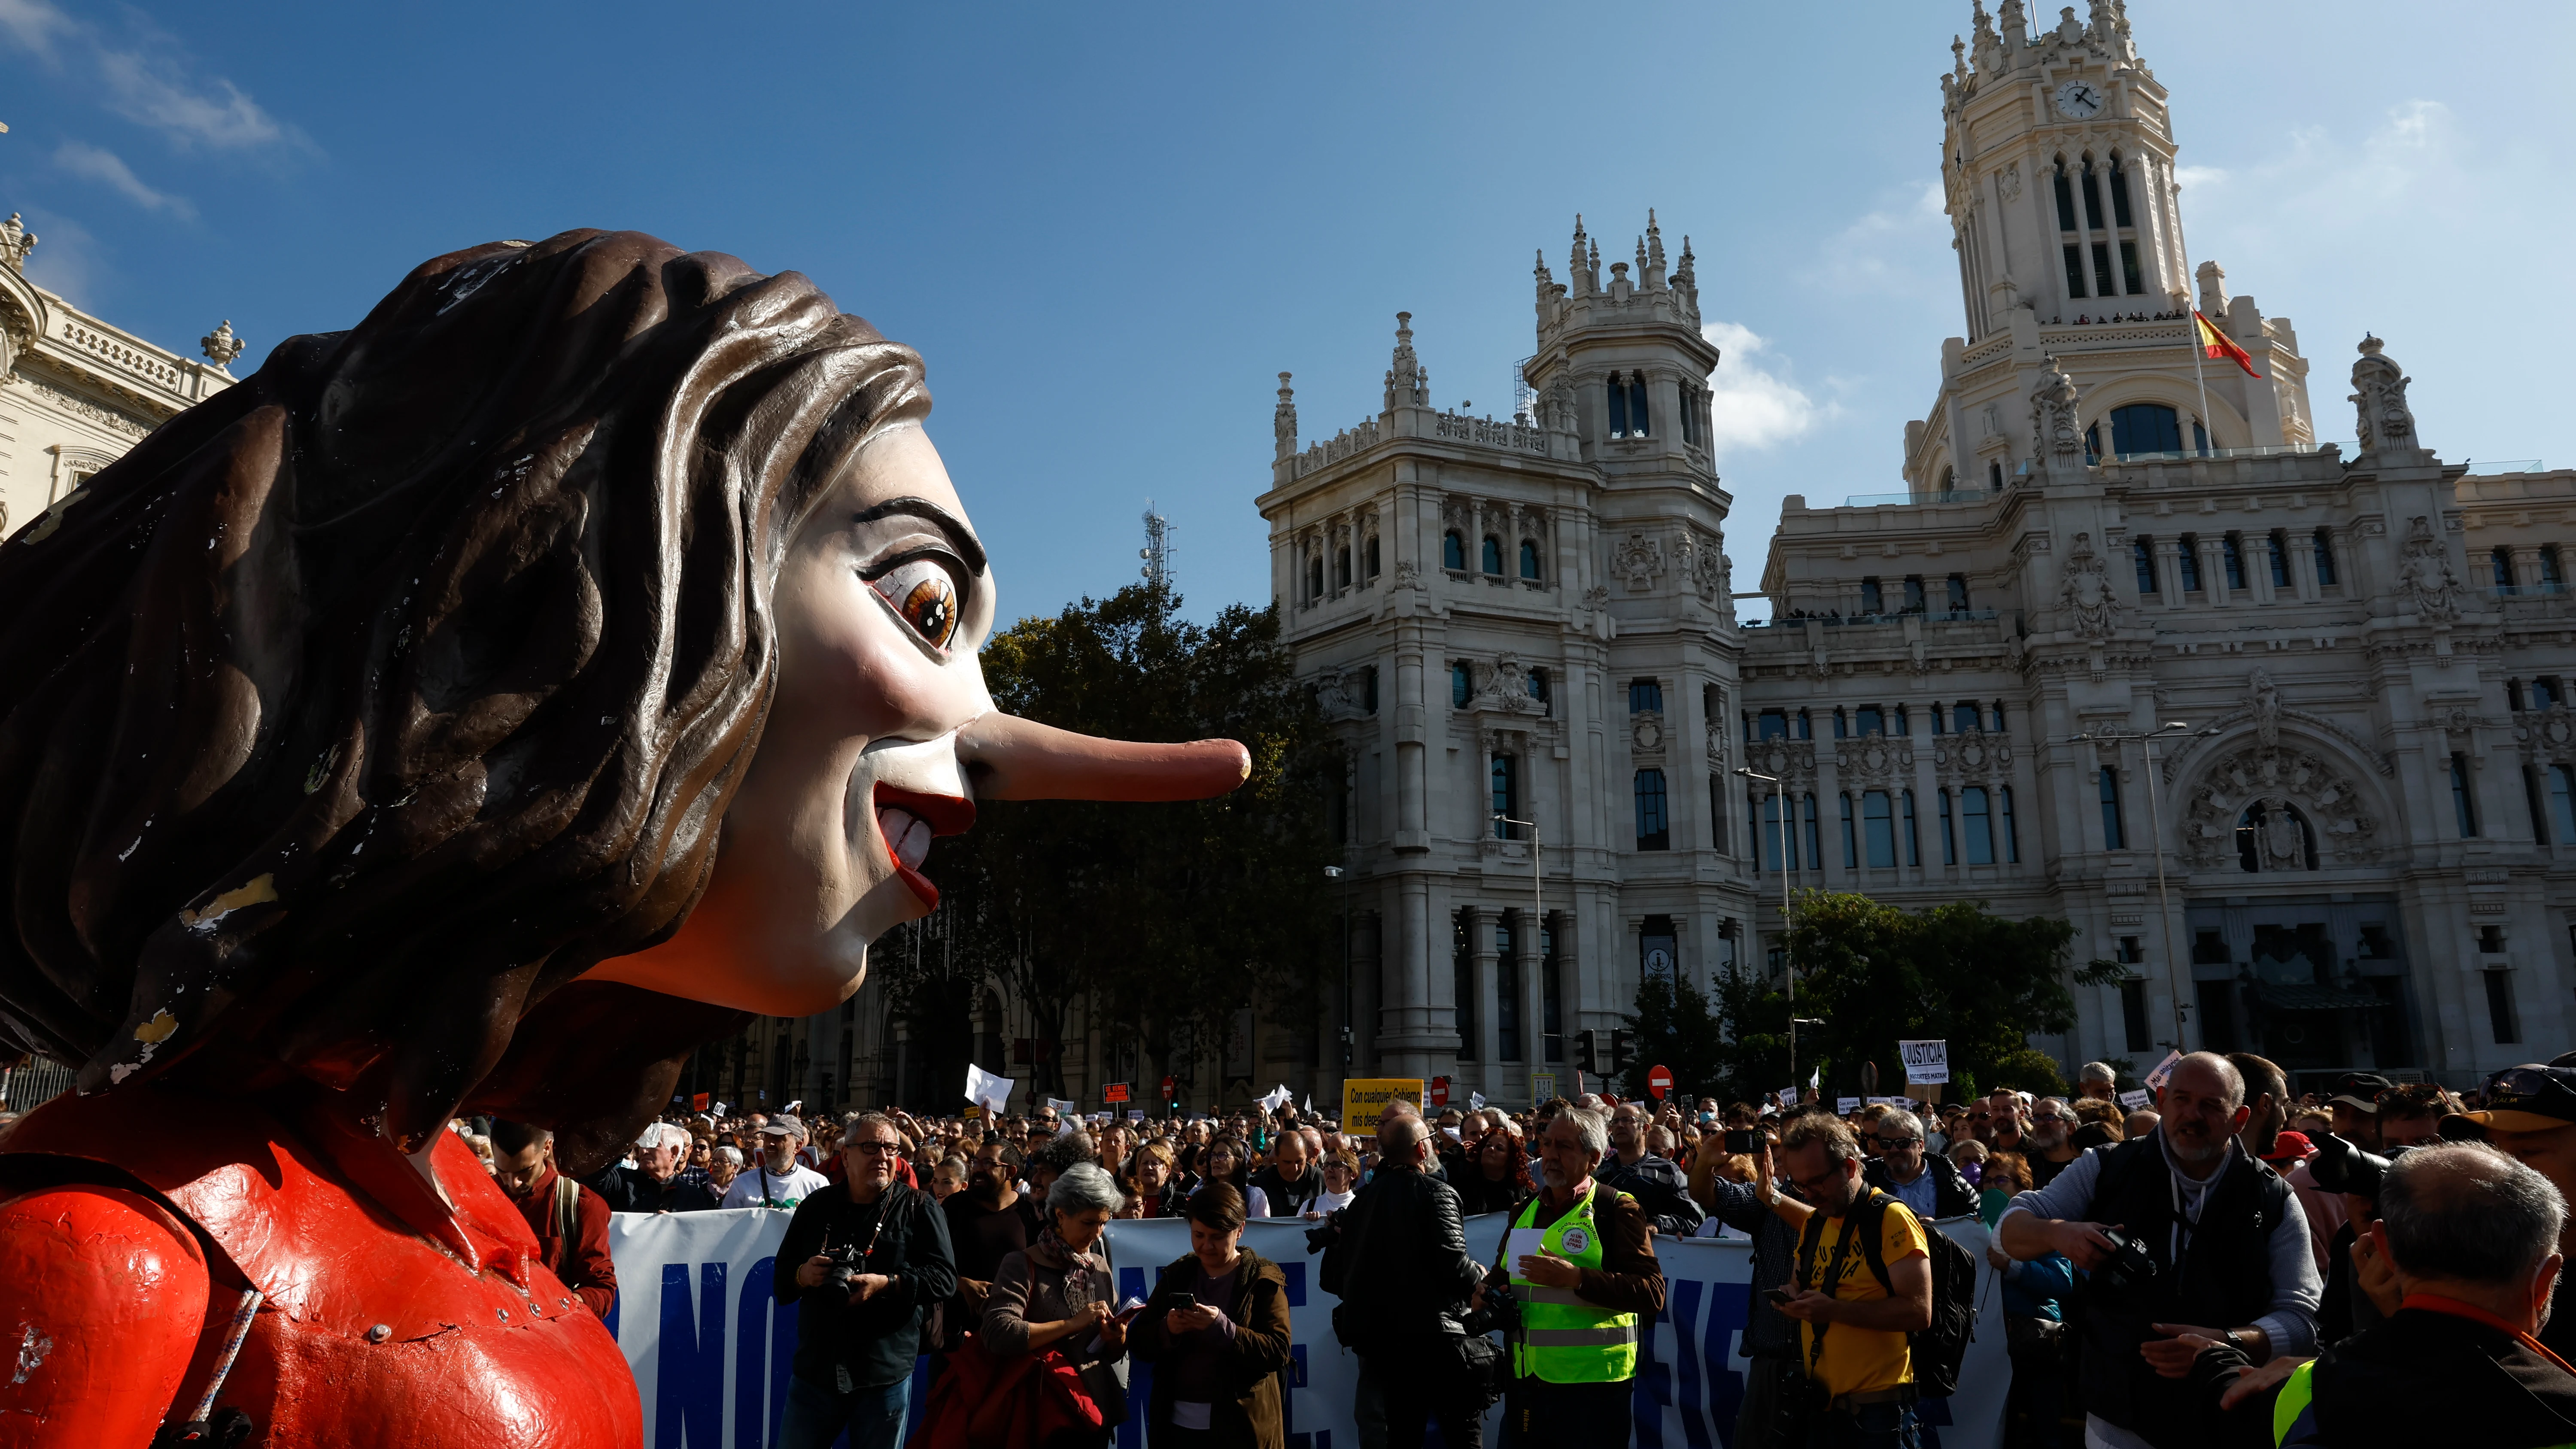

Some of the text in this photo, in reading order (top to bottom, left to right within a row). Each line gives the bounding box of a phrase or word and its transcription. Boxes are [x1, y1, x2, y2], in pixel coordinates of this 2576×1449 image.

[1902, 1042, 1945, 1064] ¡JUSTICIA!
[2151, 1075, 2162, 1087] ¡Más
[1351, 1088, 1362, 1103] Con
[1364, 1088, 1392, 1107] cualquier
[1352, 1111, 1362, 1127] mis
